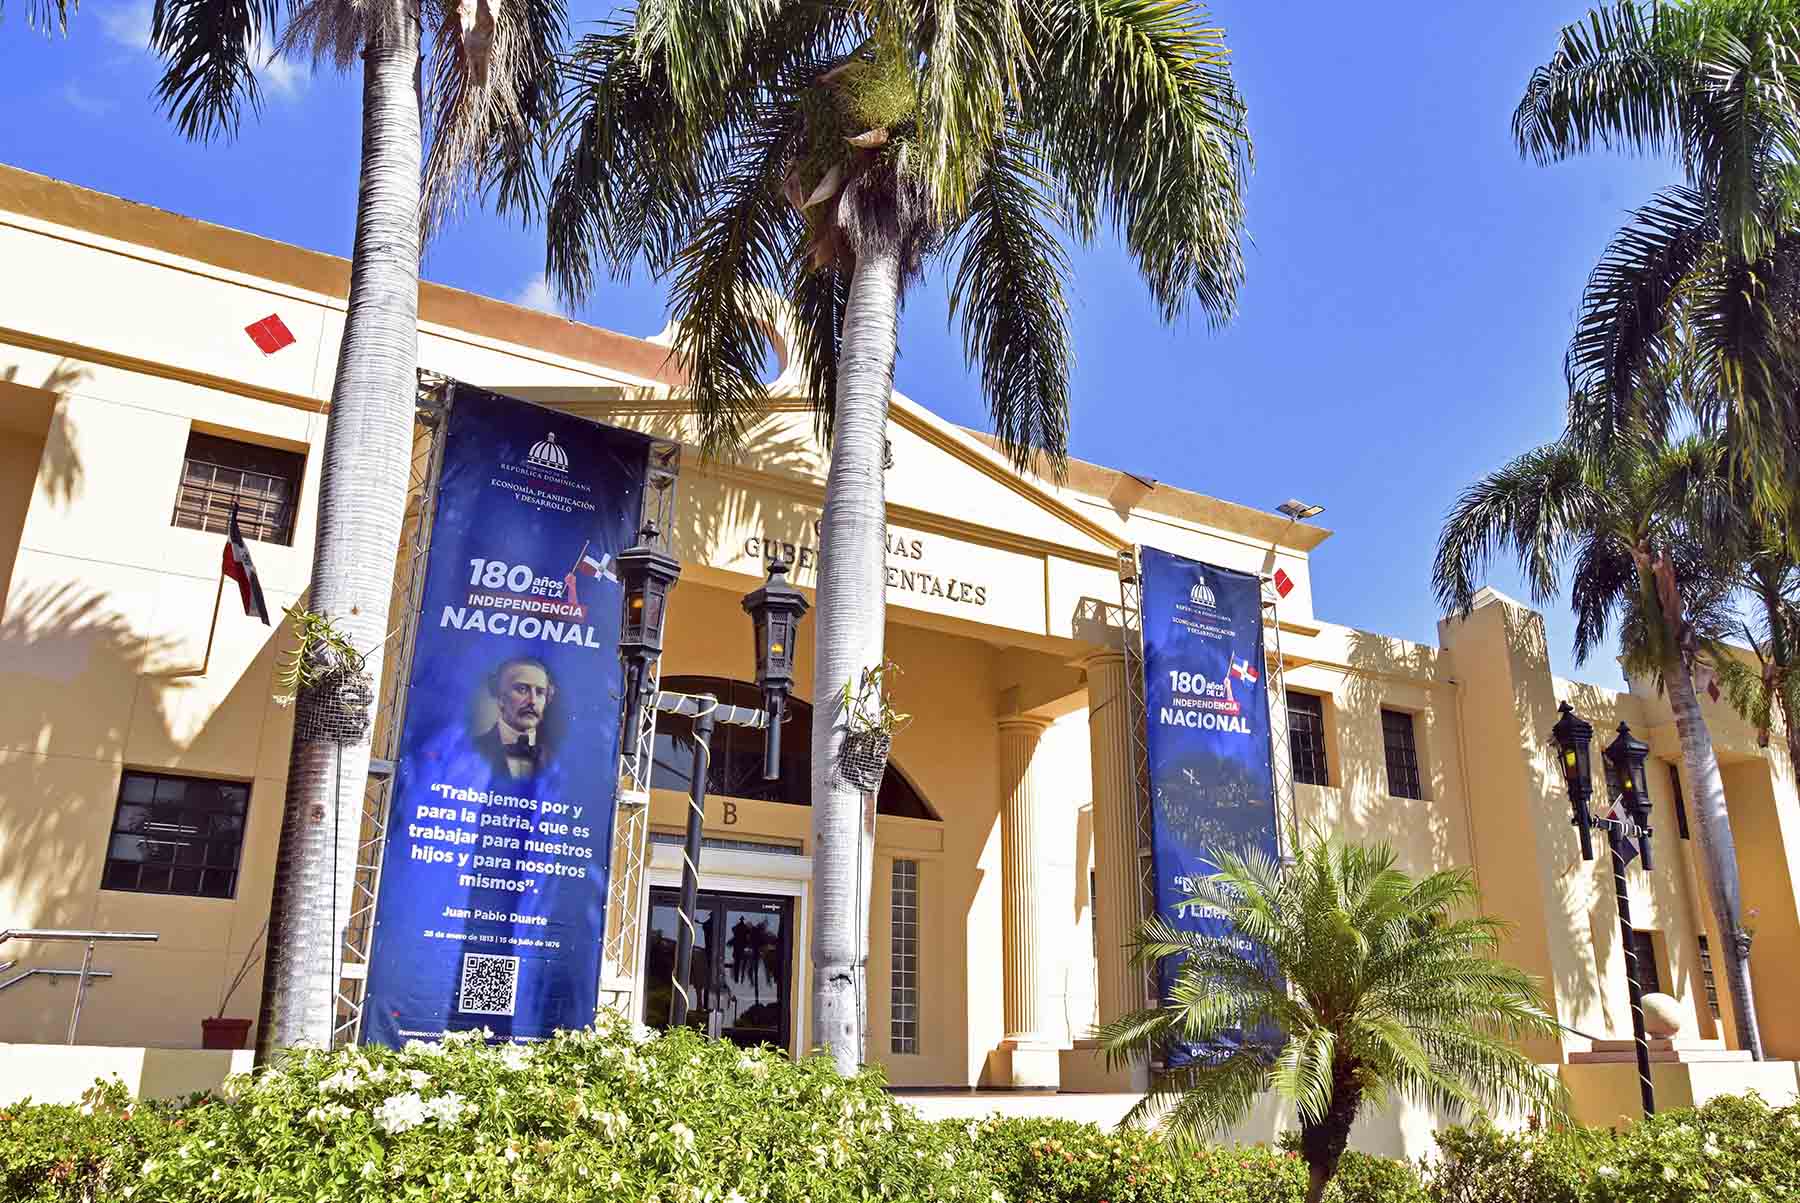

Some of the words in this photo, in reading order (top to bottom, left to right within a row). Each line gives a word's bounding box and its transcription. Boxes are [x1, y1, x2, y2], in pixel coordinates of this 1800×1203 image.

[544, 475, 591, 492] DOMINICANA
[521, 494, 572, 513] DESARROLLO
[470, 558, 533, 593] 180
[533, 575, 564, 589] años
[531, 586, 547, 597] DE
[548, 588, 563, 598] LA
[468, 594, 583, 617] INDEPENDENCIA
[440, 606, 600, 649] NACIONAL
[1169, 670, 1206, 695] 180
[1206, 681, 1224, 691] años
[1215, 690, 1224, 698] LA
[1173, 698, 1238, 711] INDEPENDENCIA
[1160, 707, 1251, 734] NACIONAL
[431, 783, 537, 811] “Trabajemos
[541, 800, 569, 816] por
[573, 804, 583, 819] y
[416, 805, 457, 820] para
[461, 807, 476, 823] la
[480, 811, 534, 833] patria,
[538, 820, 569, 838] que
[572, 825, 590, 838] es
[723, 802, 737, 825] B
[408, 823, 478, 846] trabajar
[482, 833, 521, 850] para
[524, 839, 593, 859] nuestros
[411, 845, 454, 864] hijos
[457, 852, 469, 867] y
[473, 854, 511, 871] para
[515, 860, 586, 878] nosotros
[459, 872, 539, 894] mismos”.
[442, 905, 471, 918] Juan
[474, 909, 507, 922] Pablo
[509, 912, 548, 926] Duarte
